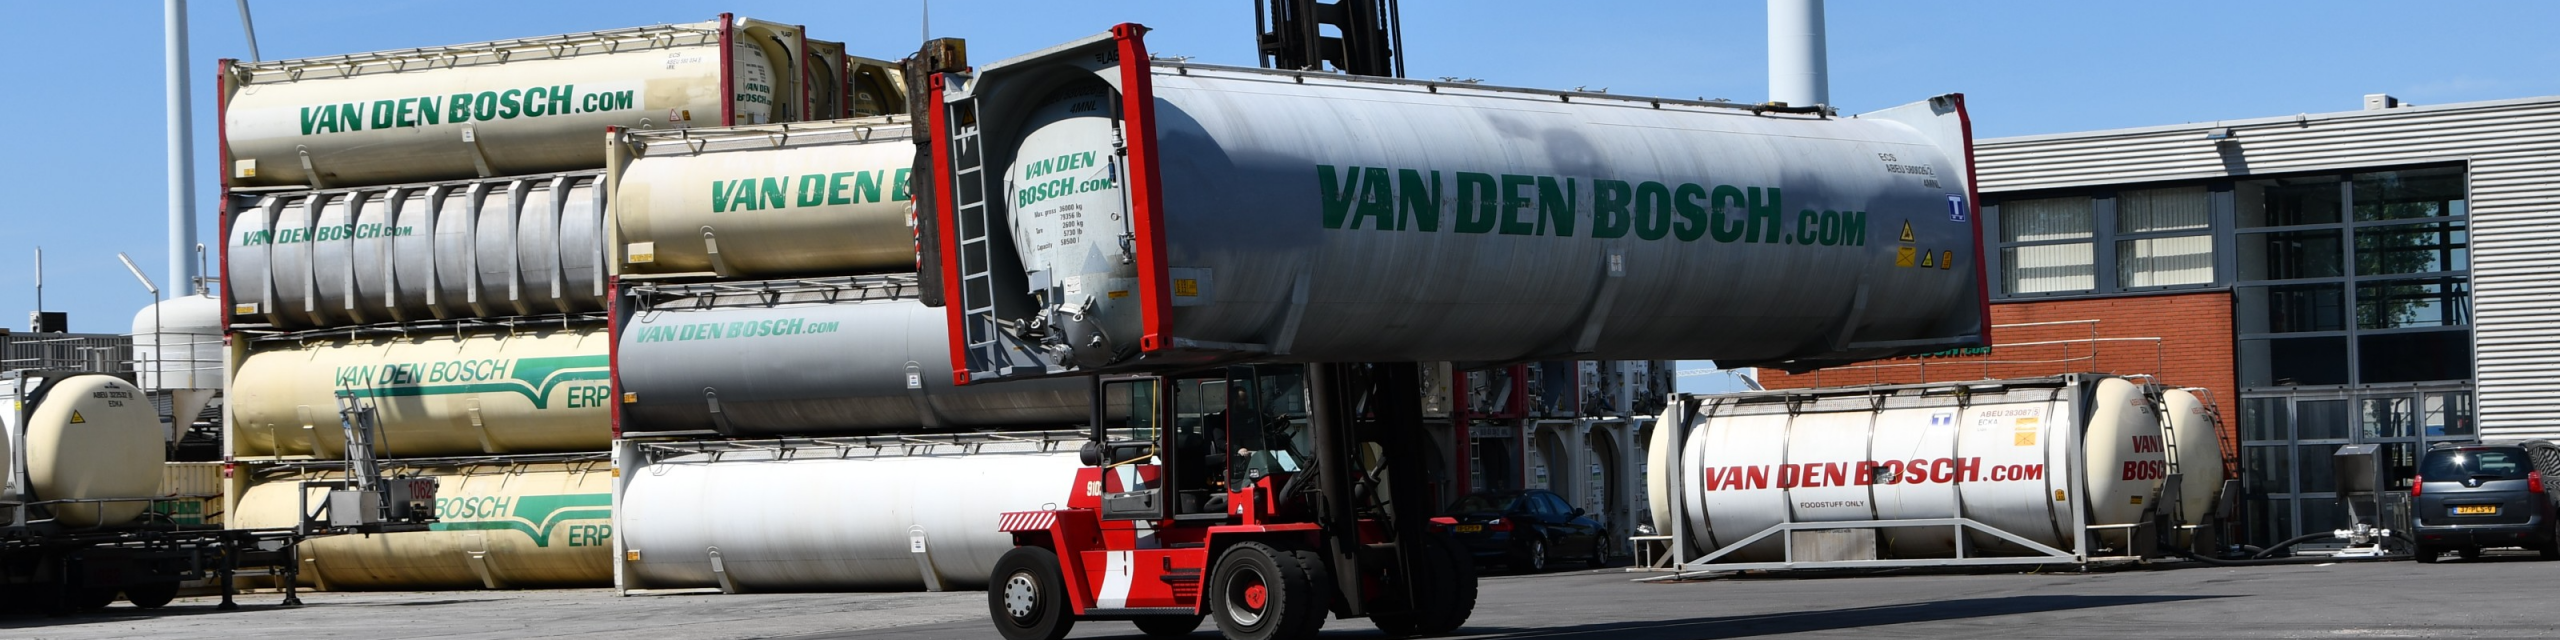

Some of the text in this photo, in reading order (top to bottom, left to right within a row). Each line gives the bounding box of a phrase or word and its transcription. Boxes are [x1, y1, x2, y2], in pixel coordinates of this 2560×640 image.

[760, 84, 770, 95] DEN
[301, 102, 364, 135] VAN
[371, 96, 442, 130] DEN
[1069, 100, 1097, 114] 4MNL
[1026, 150, 1096, 180] VAN DEN
[1878, 153, 1897, 162] ECS
[1885, 164, 1905, 173] ABEU
[712, 176, 789, 213] VAN
[797, 169, 884, 208] DEN
[1316, 164, 1441, 232] VAN
[1454, 171, 1576, 237] DEN
[1075, 203, 1082, 211] kg
[243, 229, 277, 246] VAN
[279, 226, 313, 243] DEN
[637, 326, 677, 343] VAN
[679, 322, 724, 341] DEN
[335, 359, 510, 387] VAN DEN BOSCH
[568, 385, 611, 409] ERP
[2132, 435, 2158, 453] VAN
[1706, 465, 1770, 491] VAN
[1776, 462, 1848, 488] DEN
[409, 480, 432, 499] 1062
[1086, 481, 1101, 496] 910
[569, 525, 612, 547] ERP
